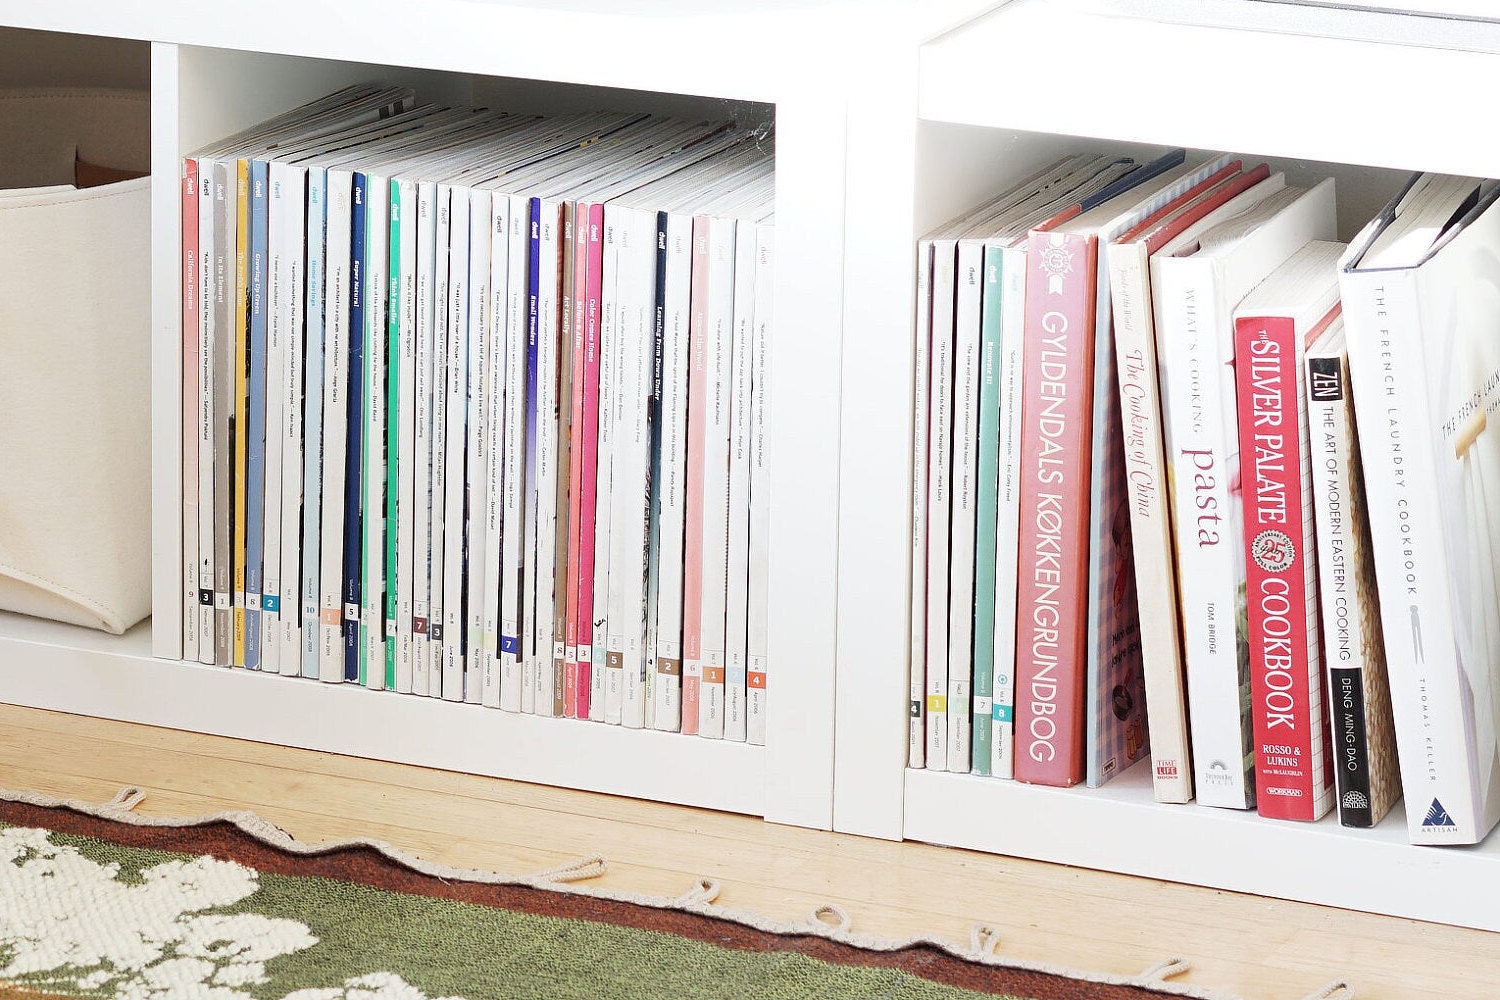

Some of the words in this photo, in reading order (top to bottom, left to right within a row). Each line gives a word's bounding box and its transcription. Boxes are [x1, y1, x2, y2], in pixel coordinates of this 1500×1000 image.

[186, 177, 195, 195] dwell
[216, 183, 224, 201] dwell
[254, 180, 262, 198] dwell
[355, 187, 363, 205] dwell
[590, 224, 598, 242] dwell
[657, 231, 665, 250] dwell
[187, 249, 195, 283] California
[218, 256, 224, 265] In
[254, 253, 262, 283] Growing
[352, 260, 360, 280] Super
[988, 265, 996, 283] dwell
[254, 283, 261, 293] Up
[309, 280, 318, 307] Savings
[529, 295, 537, 315] Small
[575, 300, 583, 322] Before
[588, 298, 596, 319] Color
[1375, 286, 1387, 317] THE
[529, 316, 537, 346] Wonders
[655, 306, 663, 337] Learning
[1258, 329, 1270, 345] THE
[587, 342, 595, 363] Home
[986, 341, 994, 374] Renovate
[1379, 329, 1396, 396] FRENCH
[654, 358, 662, 377] Down
[1125, 349, 1144, 380] The
[1249, 340, 1283, 427] SILVER
[1313, 372, 1339, 397] ZEN
[1038, 310, 1068, 483] GYLDENDALS
[1189, 359, 1204, 433] COOKING
[1122, 383, 1149, 447] Cooking
[1323, 406, 1335, 428] THE
[1442, 417, 1456, 441] THE
[1325, 432, 1337, 454] ART
[1387, 408, 1407, 489] LAUNDRY
[1129, 451, 1153, 467] of
[1326, 458, 1338, 475] OF
[1254, 434, 1287, 524] PALATE
[1129, 470, 1157, 517] China
[1181, 447, 1222, 548] pasta
[1327, 479, 1342, 535] MODERN
[1260, 538, 1287, 563] 25
[1398, 499, 1417, 596] COOKBOOK
[1332, 539, 1346, 593] EASTERN
[267, 599, 274, 608] 2
[306, 606, 315, 614] 10
[1207, 602, 1215, 621] TOM
[417, 621, 423, 630] 7
[1029, 492, 1064, 763] KØKKENGRUNDBOG
[1335, 597, 1351, 661] COOKING
[505, 640, 512, 649] 7
[1207, 624, 1217, 655] BRIDGE
[611, 656, 618, 664] 5
[1260, 577, 1295, 730] COOKBOOK
[665, 662, 671, 671] 2
[753, 676, 760, 685] 4
[1341, 678, 1353, 709] DENG
[998, 708, 1005, 718] 8
[1419, 678, 1431, 728] THOMAS
[1425, 737, 1436, 782] KELLER
[1262, 744, 1291, 755] ROSSO
[1293, 746, 1301, 756] &
[1157, 767, 1177, 775] LIFE
[1266, 756, 1298, 767] LUKINS
